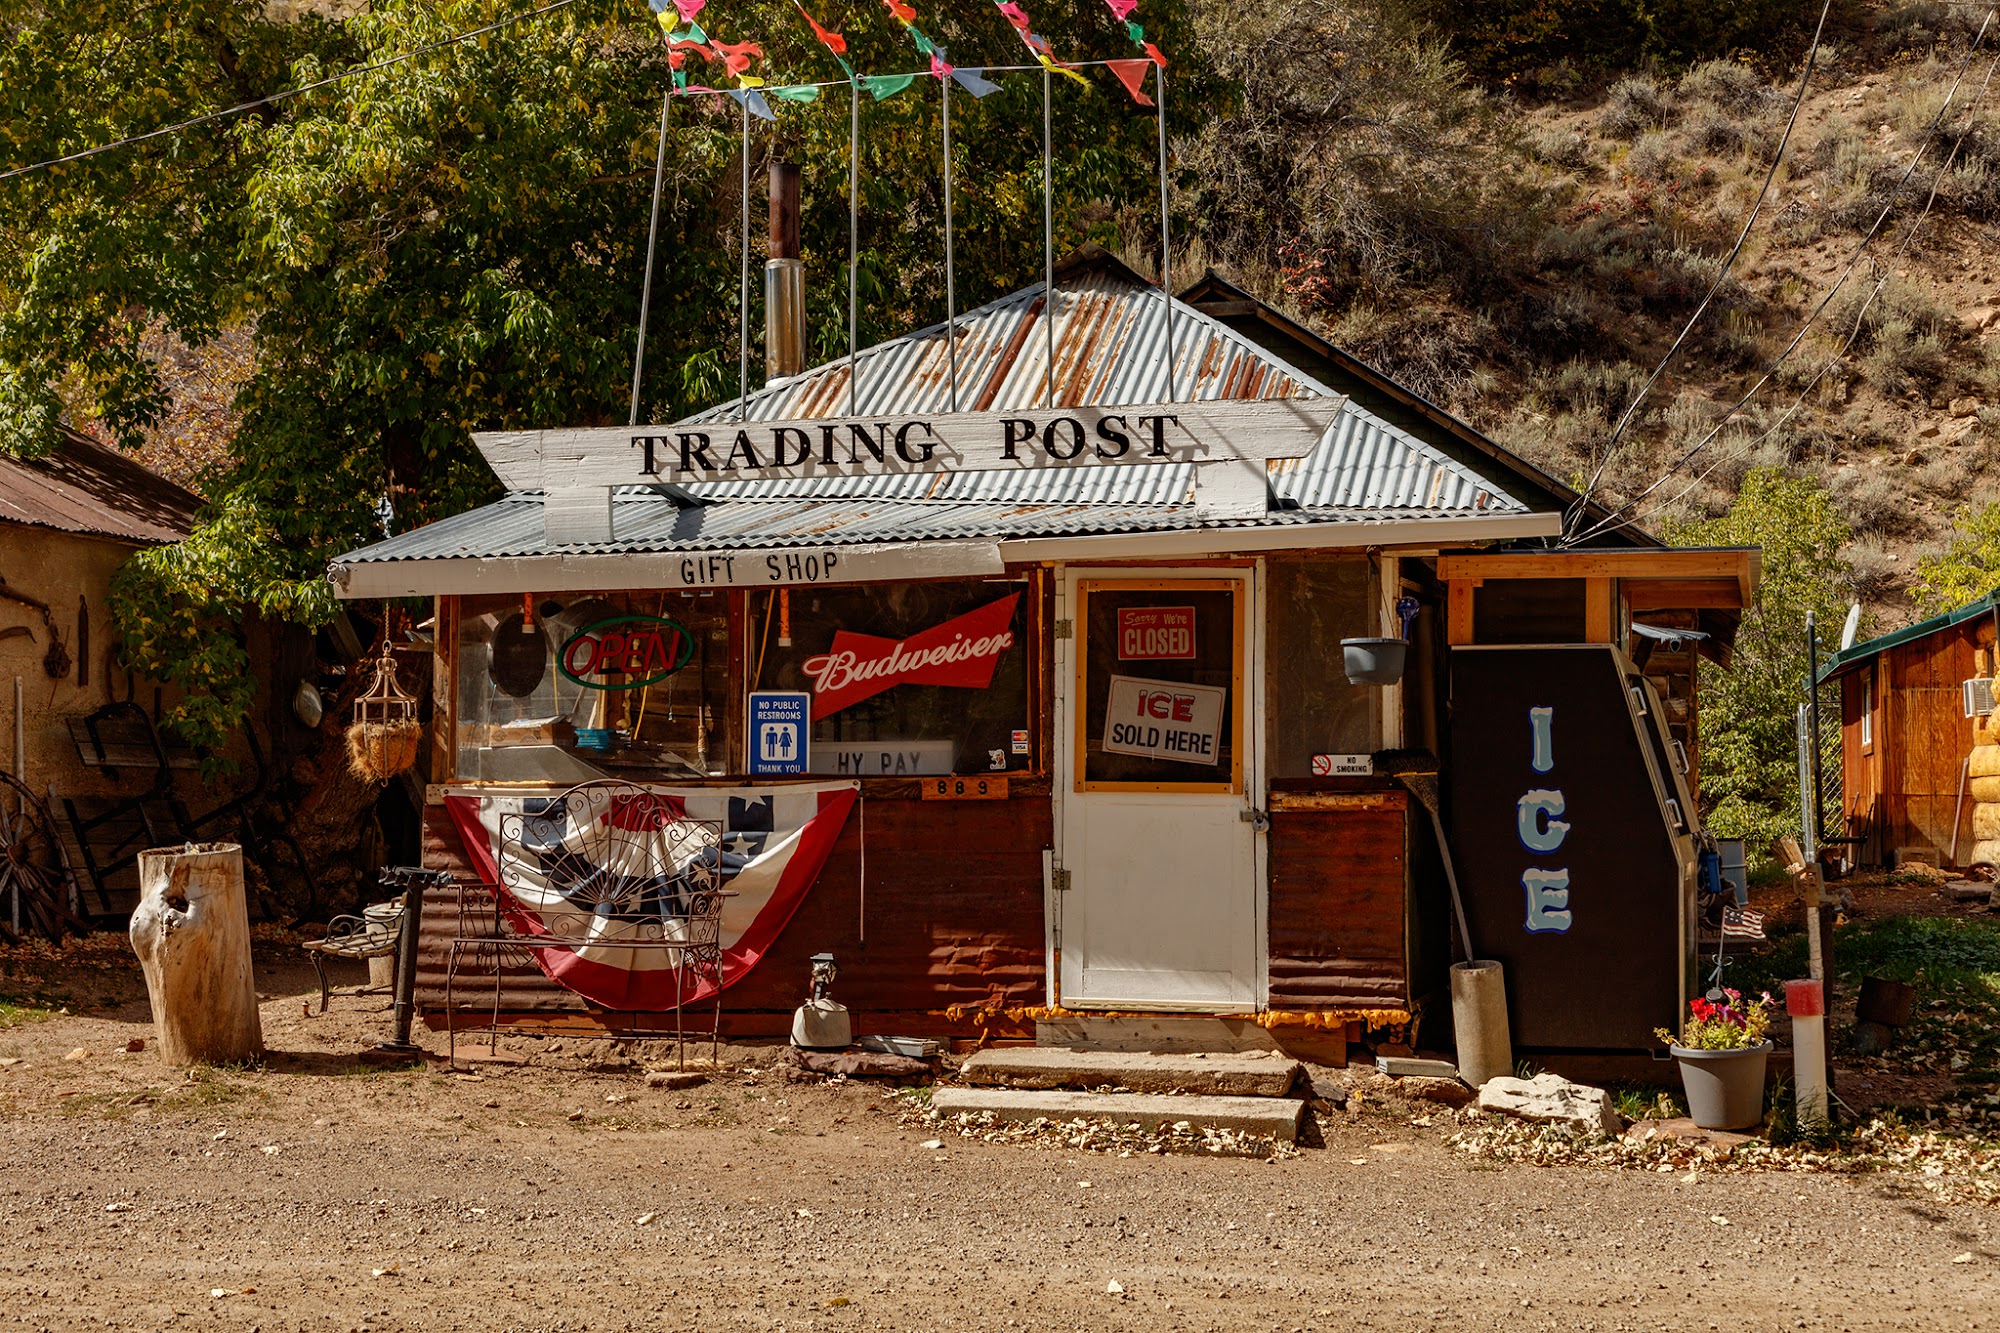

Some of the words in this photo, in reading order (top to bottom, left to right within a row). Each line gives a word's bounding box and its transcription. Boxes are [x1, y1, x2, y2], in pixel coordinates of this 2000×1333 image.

[631, 421, 933, 475] TRADING
[999, 415, 1178, 460] POST
[681, 556, 735, 585] GIFT
[766, 551, 837, 582] SHOP
[1124, 612, 1158, 626] Sorry
[1163, 613, 1187, 625] We're
[566, 630, 681, 677] OPEN
[1124, 628, 1190, 656] CLOSED
[802, 632, 1013, 693] Budweiser
[757, 711, 801, 720] RESTROOMS
[758, 701, 770, 710] NO
[772, 701, 800, 710] PUBLIC
[1137, 689, 1196, 722] ICE
[1112, 723, 1160, 748] SOLD
[1164, 729, 1213, 755] HERE
[757, 764, 782, 773] THANK
[785, 764, 801, 774] YOU
[837, 752, 864, 774] HY
[880, 752, 921, 775] PAY
[1336, 765, 1368, 773] SMOKING
[1346, 756, 1357, 764] NO
[1517, 705, 1572, 935] ICE
